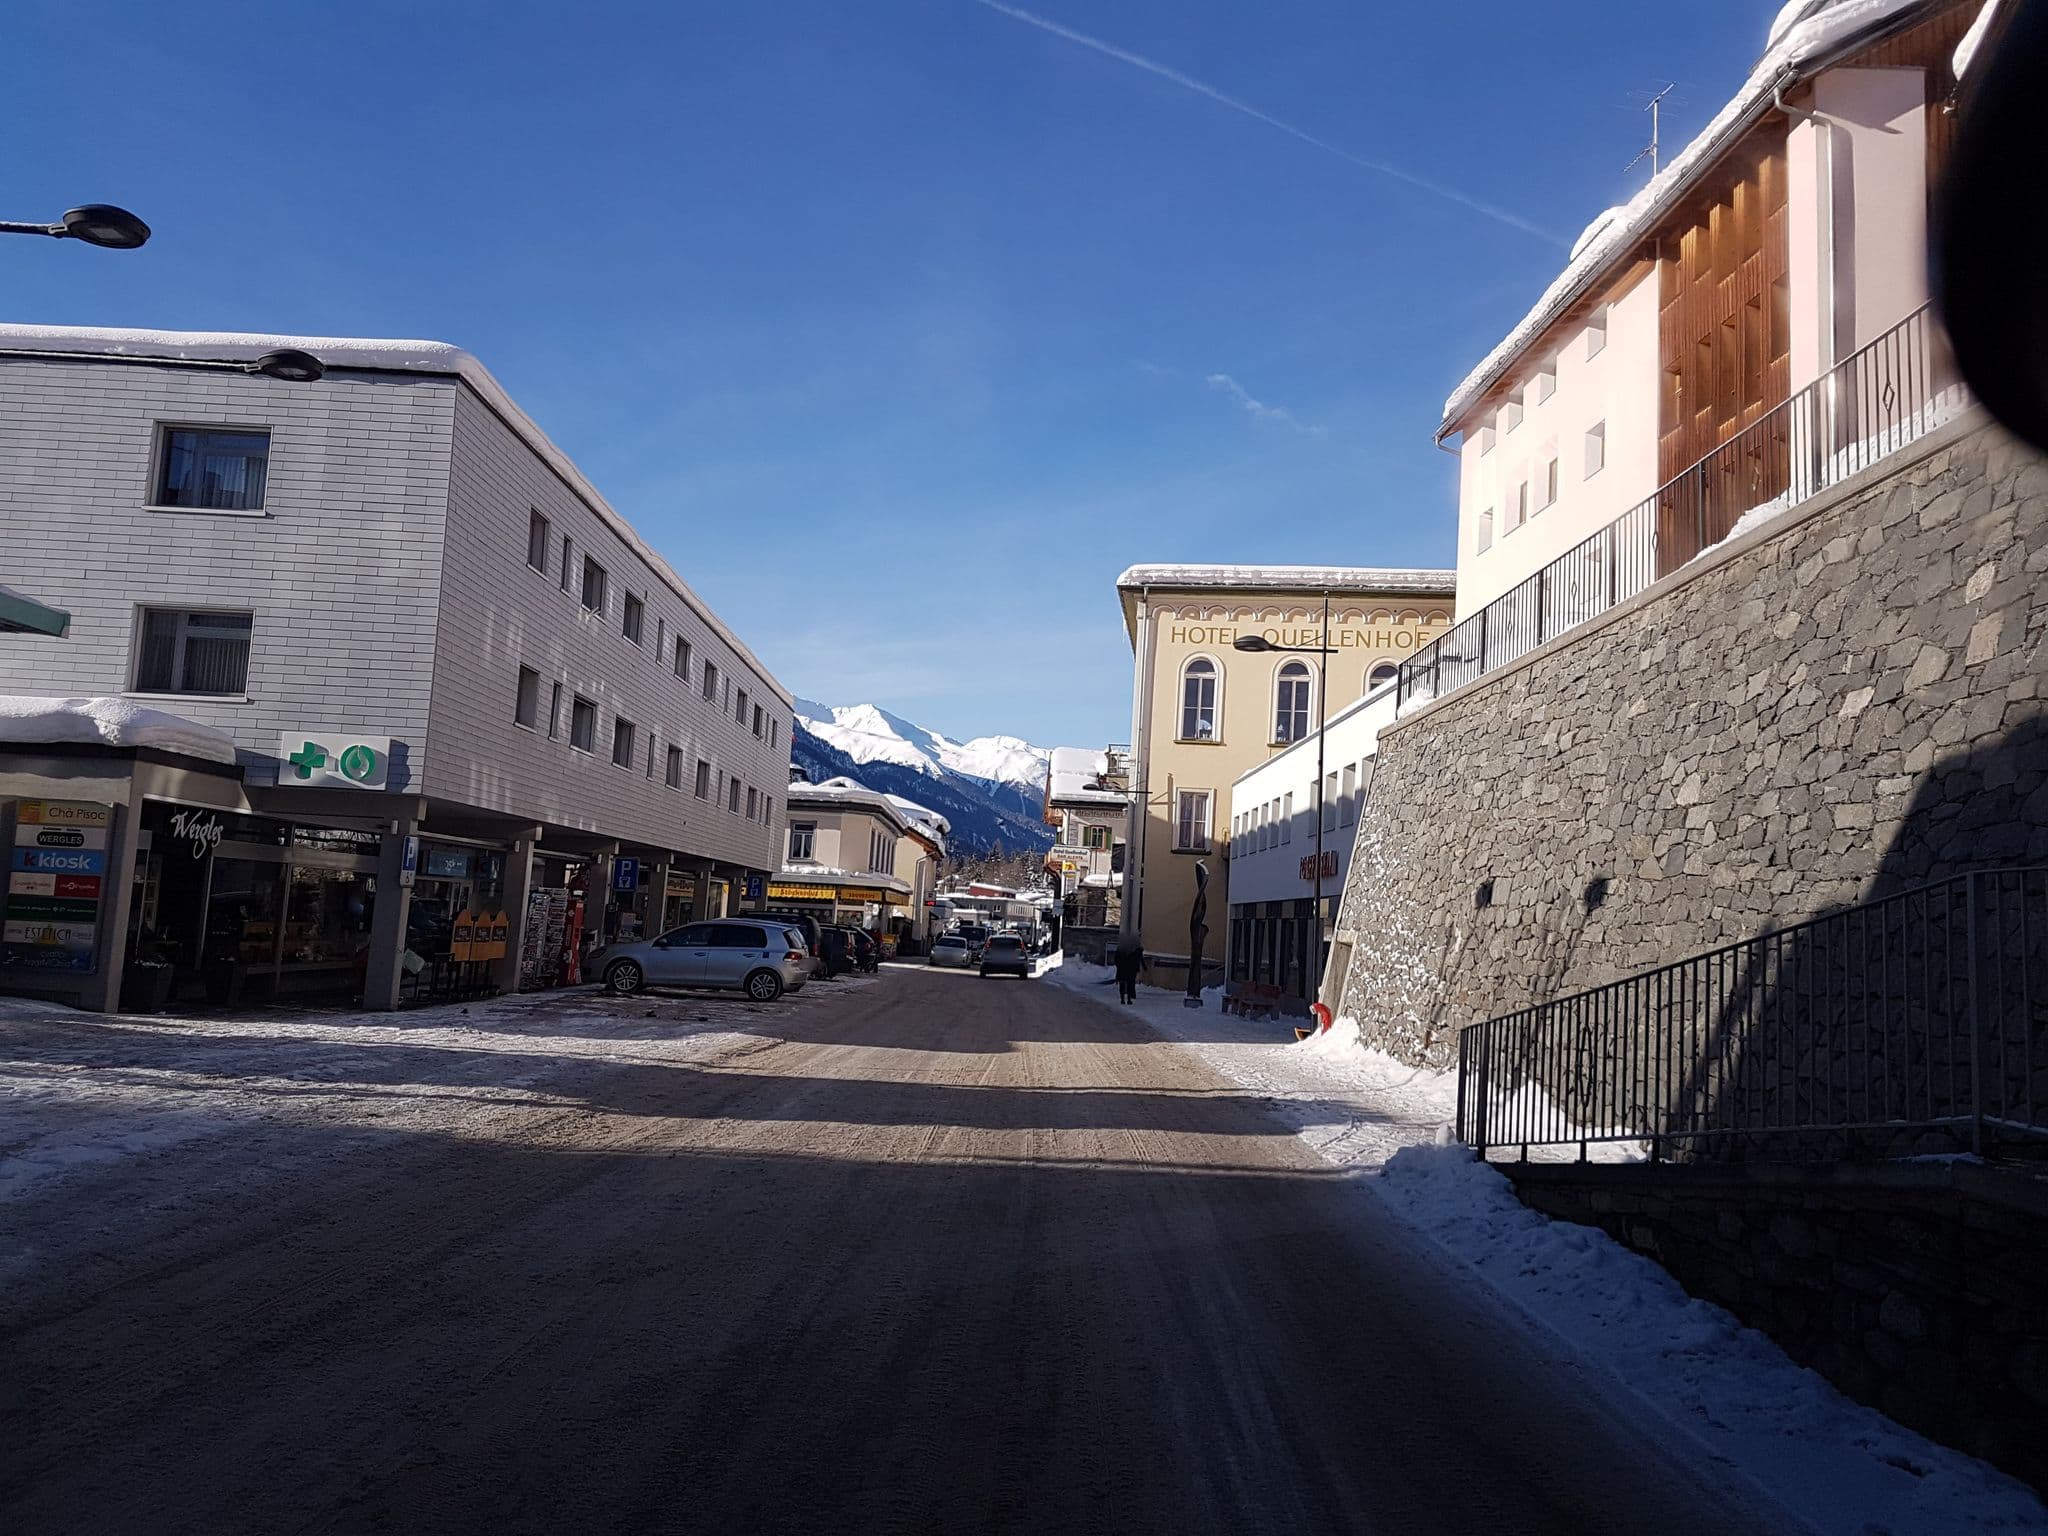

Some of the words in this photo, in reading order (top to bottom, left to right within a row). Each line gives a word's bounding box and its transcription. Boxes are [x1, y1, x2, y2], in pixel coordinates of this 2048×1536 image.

[1171, 626, 1239, 644] HOTEL
[1262, 628, 1430, 649] QUELLENHOF
[39, 834, 82, 845] WERGLES
[170, 809, 224, 859] Wergles
[38, 852, 92, 870] kiosk
[621, 860, 632, 876] P
[752, 878, 760, 888] P
